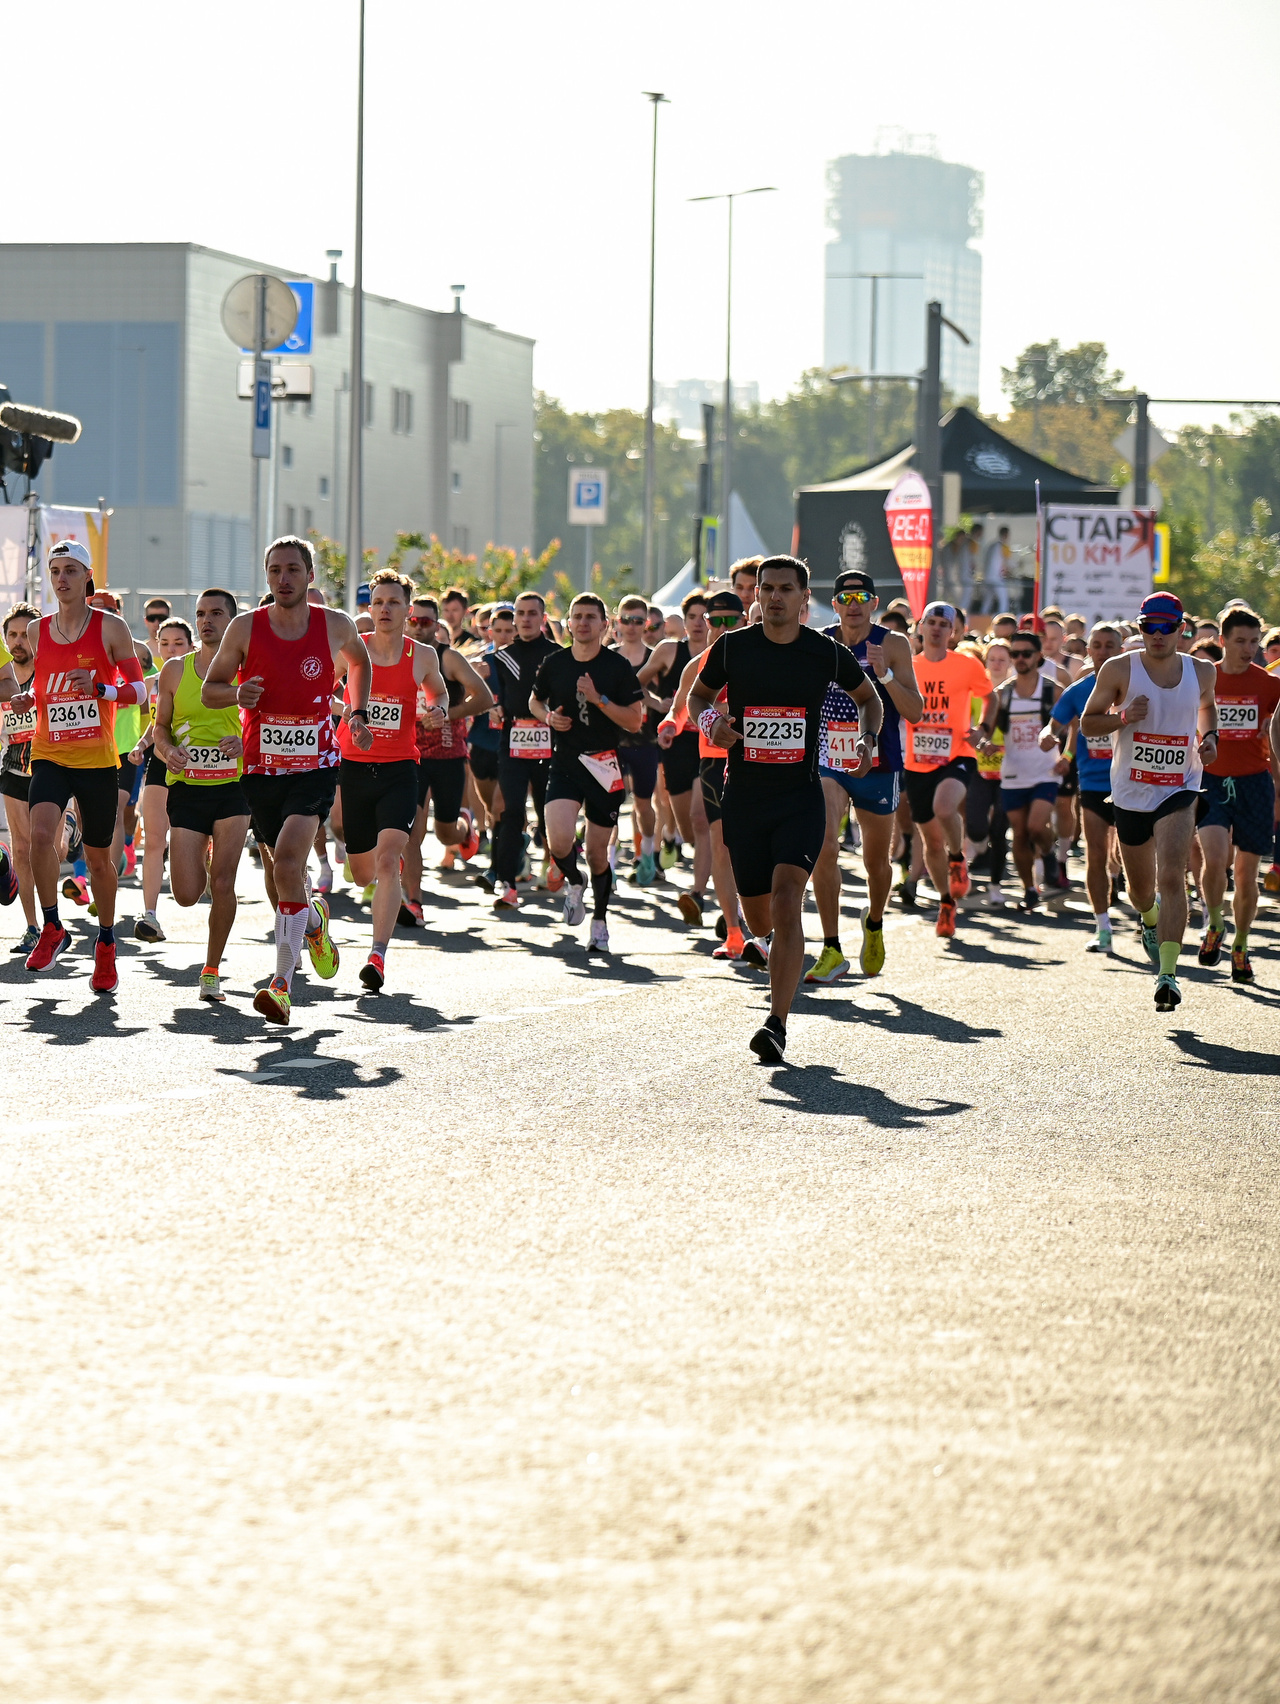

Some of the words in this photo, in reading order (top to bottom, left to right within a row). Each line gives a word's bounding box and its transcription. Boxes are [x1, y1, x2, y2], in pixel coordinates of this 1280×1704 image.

[1047, 515, 1152, 542] СТАРТ
[1050, 542, 1077, 564] 10
[1084, 544, 1122, 566] КМ
[924, 681, 944, 694] WE
[50, 704, 97, 722] 23616
[368, 705, 399, 721] 828
[1218, 709, 1256, 721] 5290
[262, 728, 316, 746] 33486
[512, 731, 548, 742] 22403
[746, 722, 803, 739] 22235
[830, 737, 855, 752] 411
[914, 736, 949, 749] 35905
[1134, 746, 1185, 765] 25008
